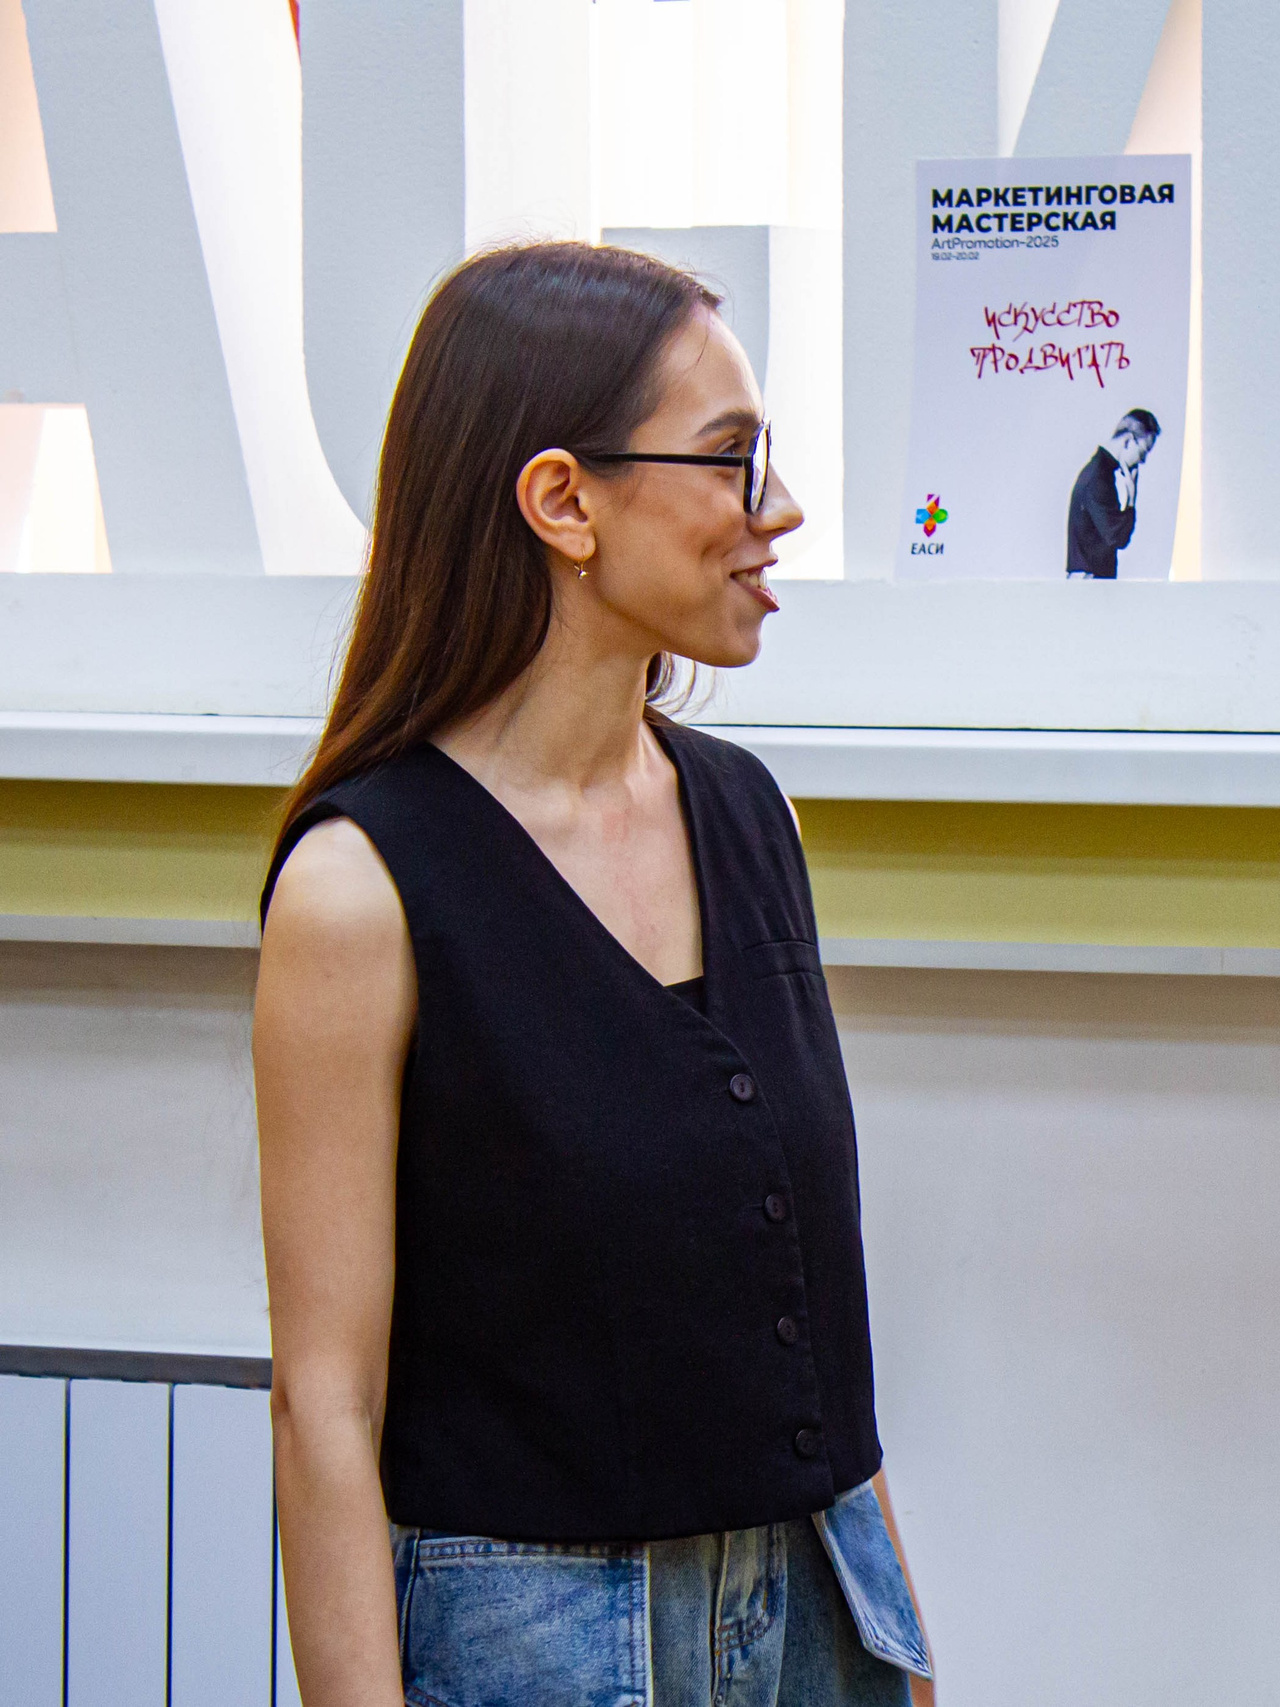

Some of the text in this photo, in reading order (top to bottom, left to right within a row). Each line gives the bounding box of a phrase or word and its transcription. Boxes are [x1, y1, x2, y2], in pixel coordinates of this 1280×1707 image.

[932, 184, 1175, 208] МАРКЕТИНГОВАЯ
[932, 210, 1117, 234] МАСТЕРСКАЯ
[931, 235, 1060, 250] ArtPromotion-2025
[910, 542, 945, 556] ЕАСИ
